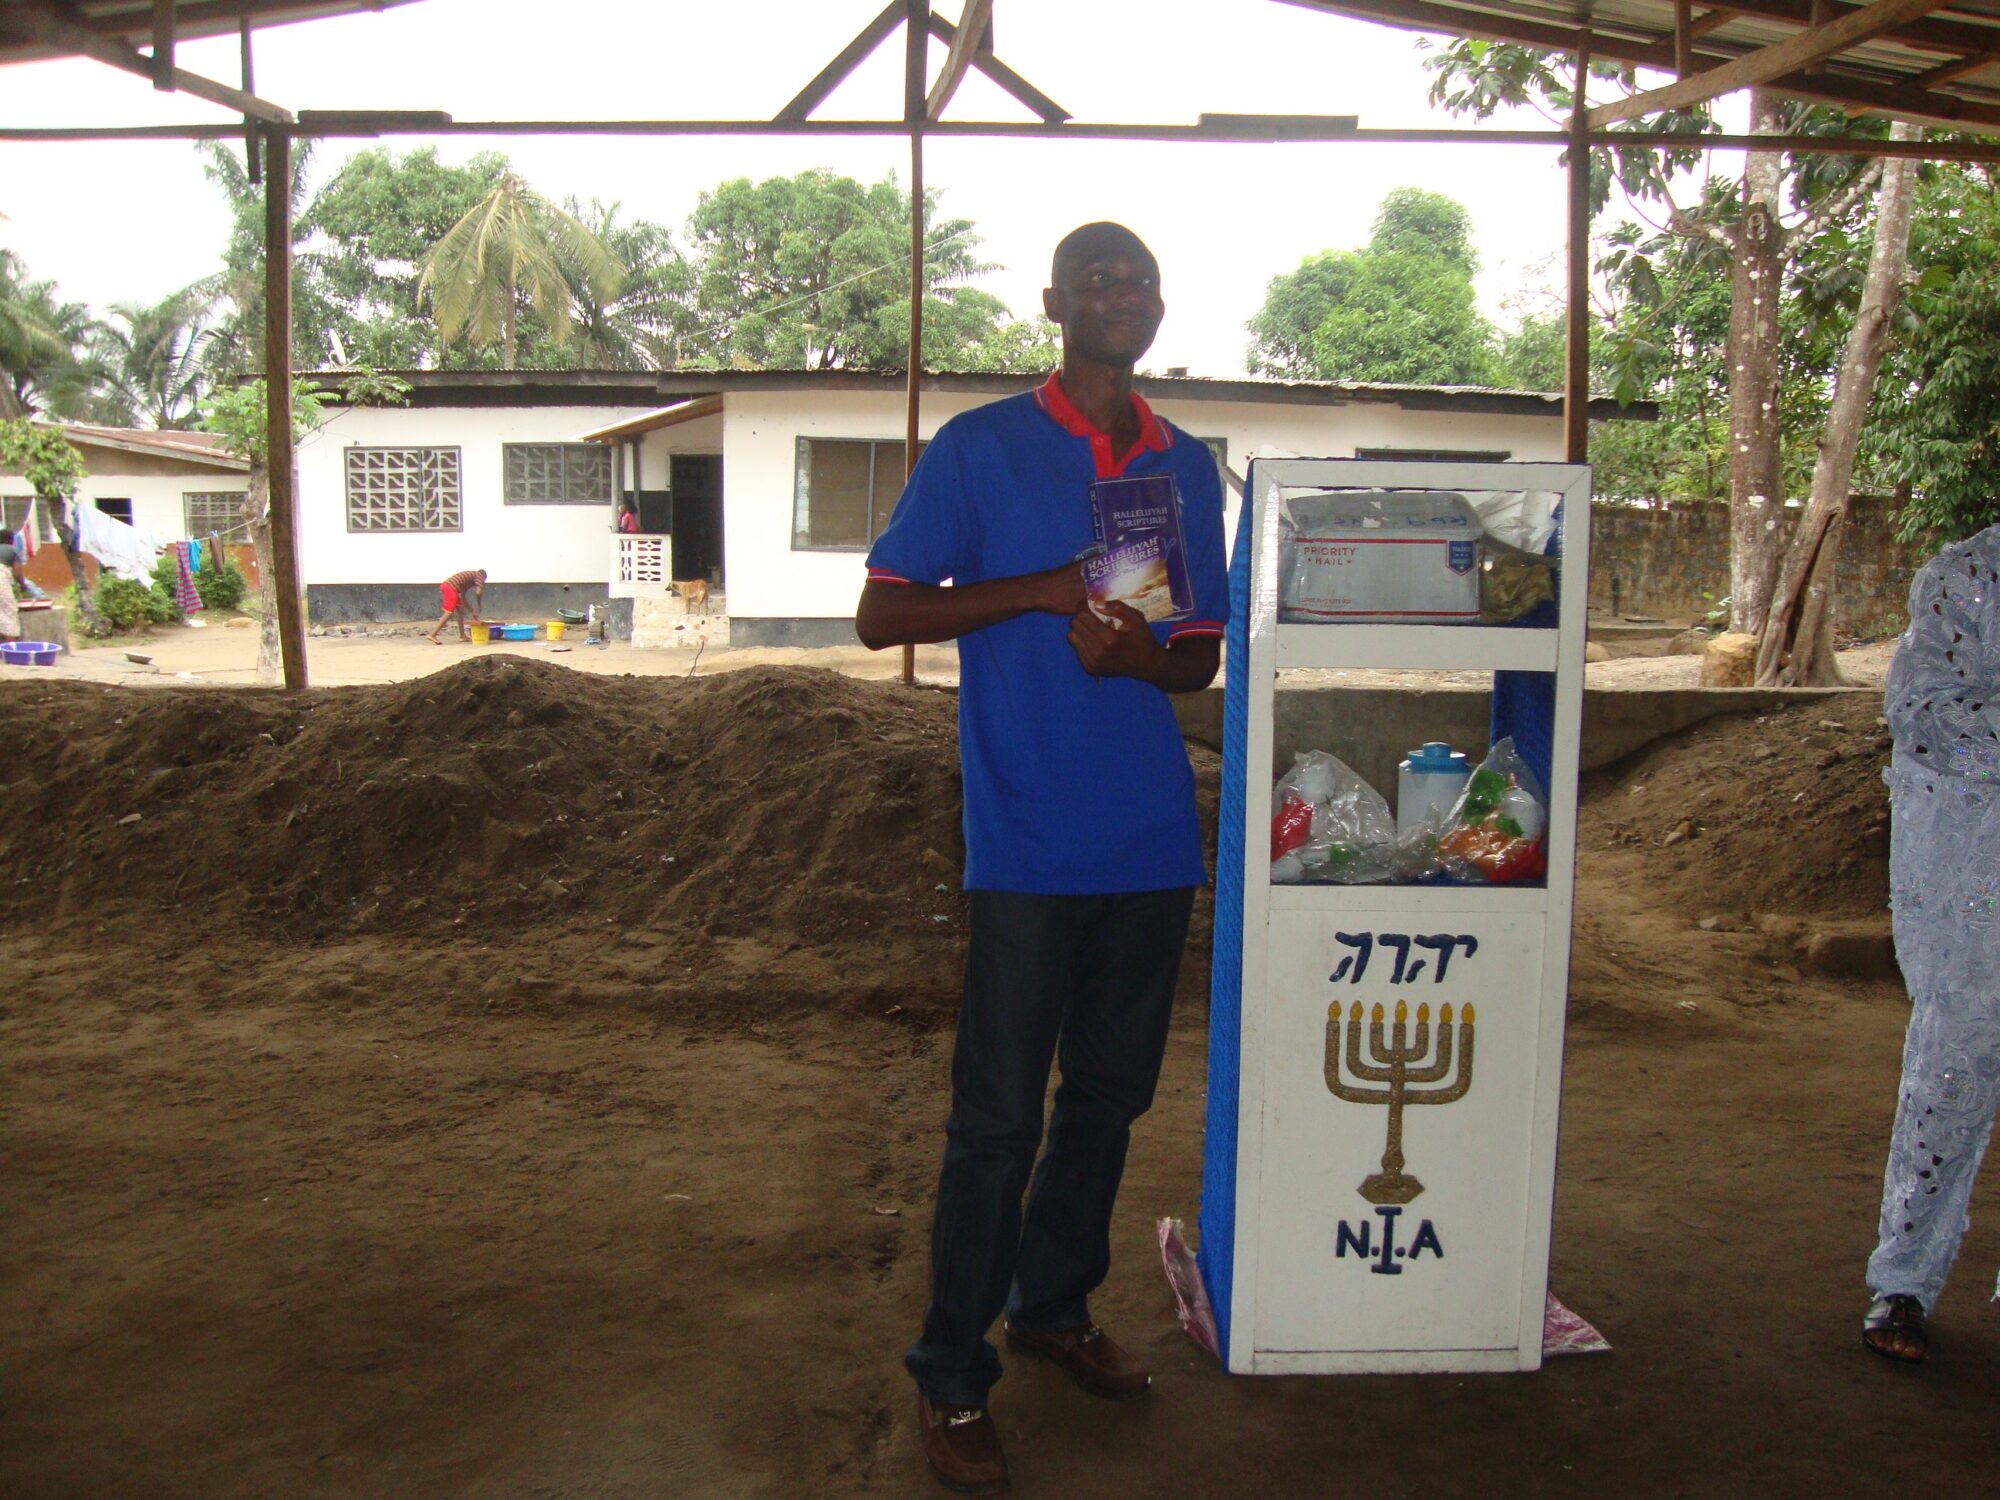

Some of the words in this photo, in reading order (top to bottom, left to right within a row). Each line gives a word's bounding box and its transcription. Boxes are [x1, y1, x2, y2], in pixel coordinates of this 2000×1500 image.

[1113, 507, 1168, 519] HALLELUYAH
[1117, 516, 1167, 528] SCRIPTURES
[1088, 536, 1158, 571] HALLELUYAH
[1304, 547, 1357, 556] PRIORITY
[1315, 557, 1343, 566] MAIL
[1335, 1206, 1444, 1275] N.I.A
